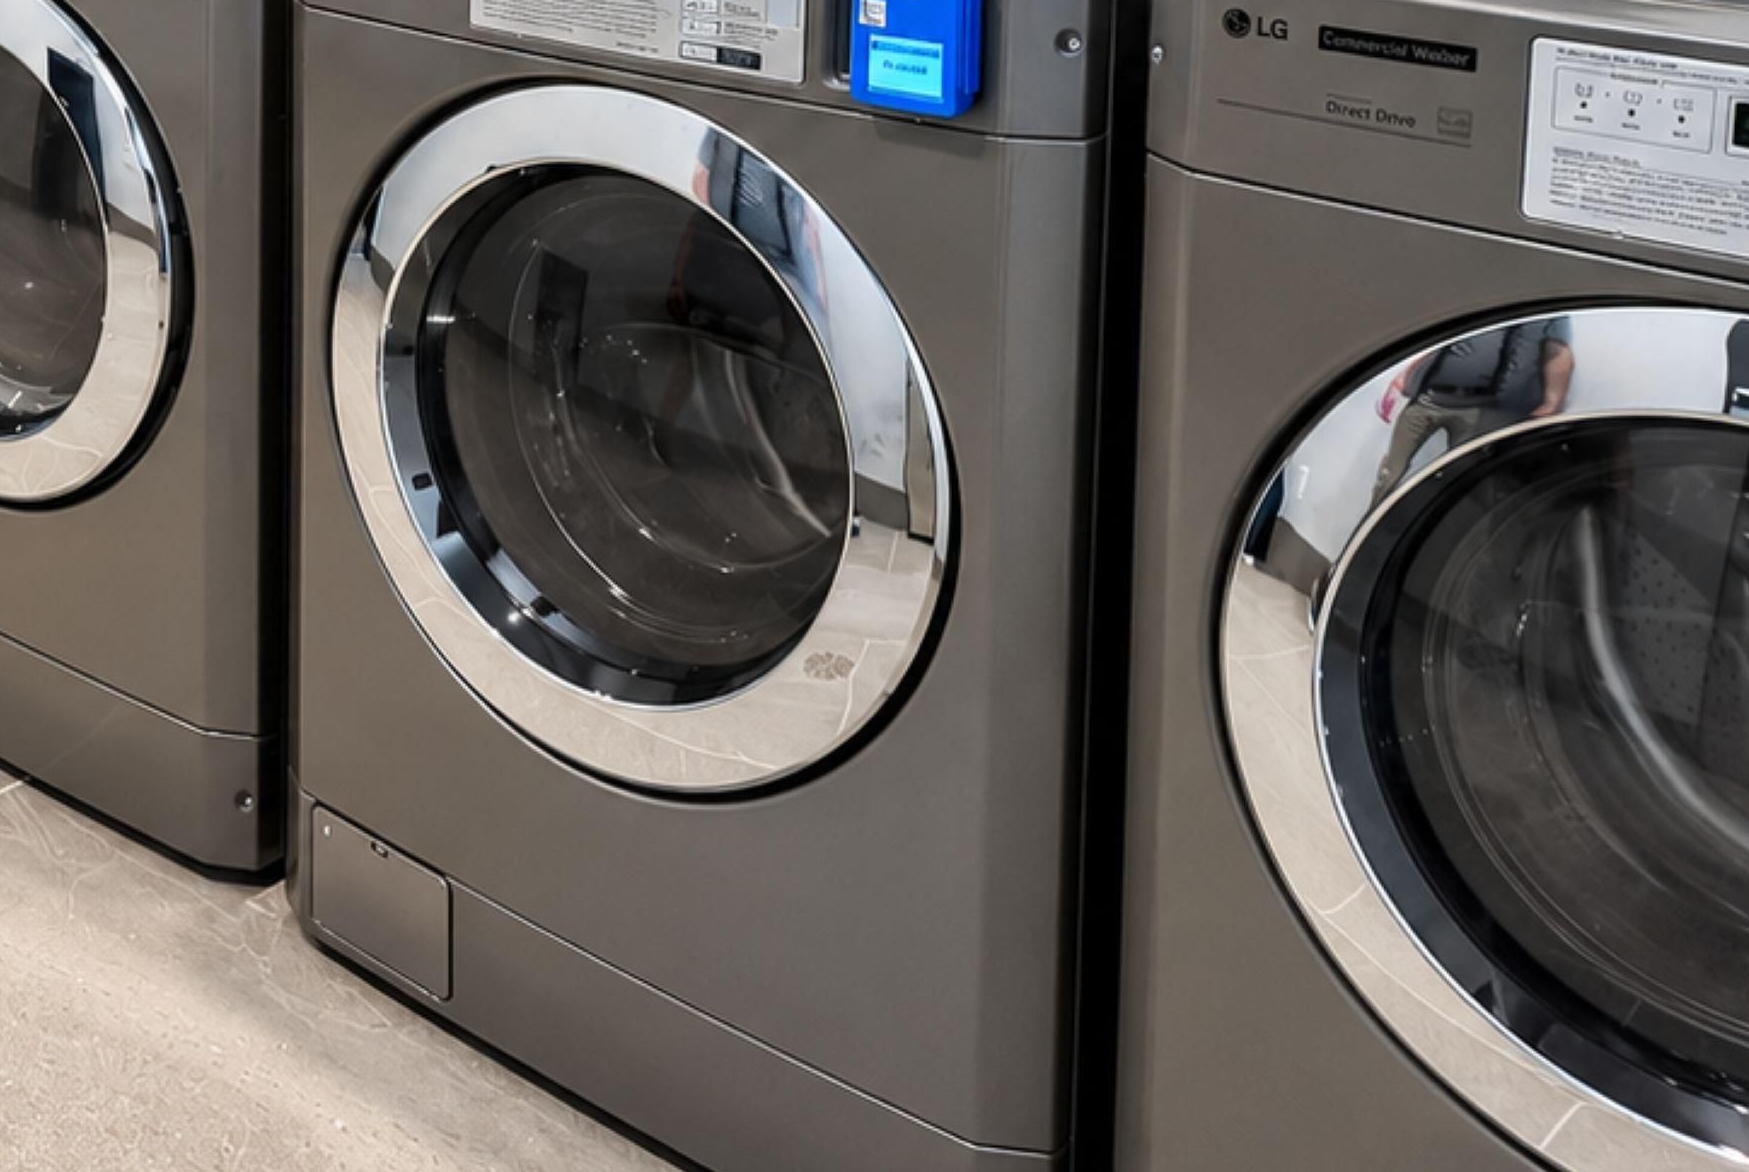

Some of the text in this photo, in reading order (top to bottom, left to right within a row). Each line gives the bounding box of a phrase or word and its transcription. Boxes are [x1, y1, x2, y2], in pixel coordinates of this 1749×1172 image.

[1257, 15, 1289, 41] LG
[1325, 99, 1417, 129] Direct Drive
